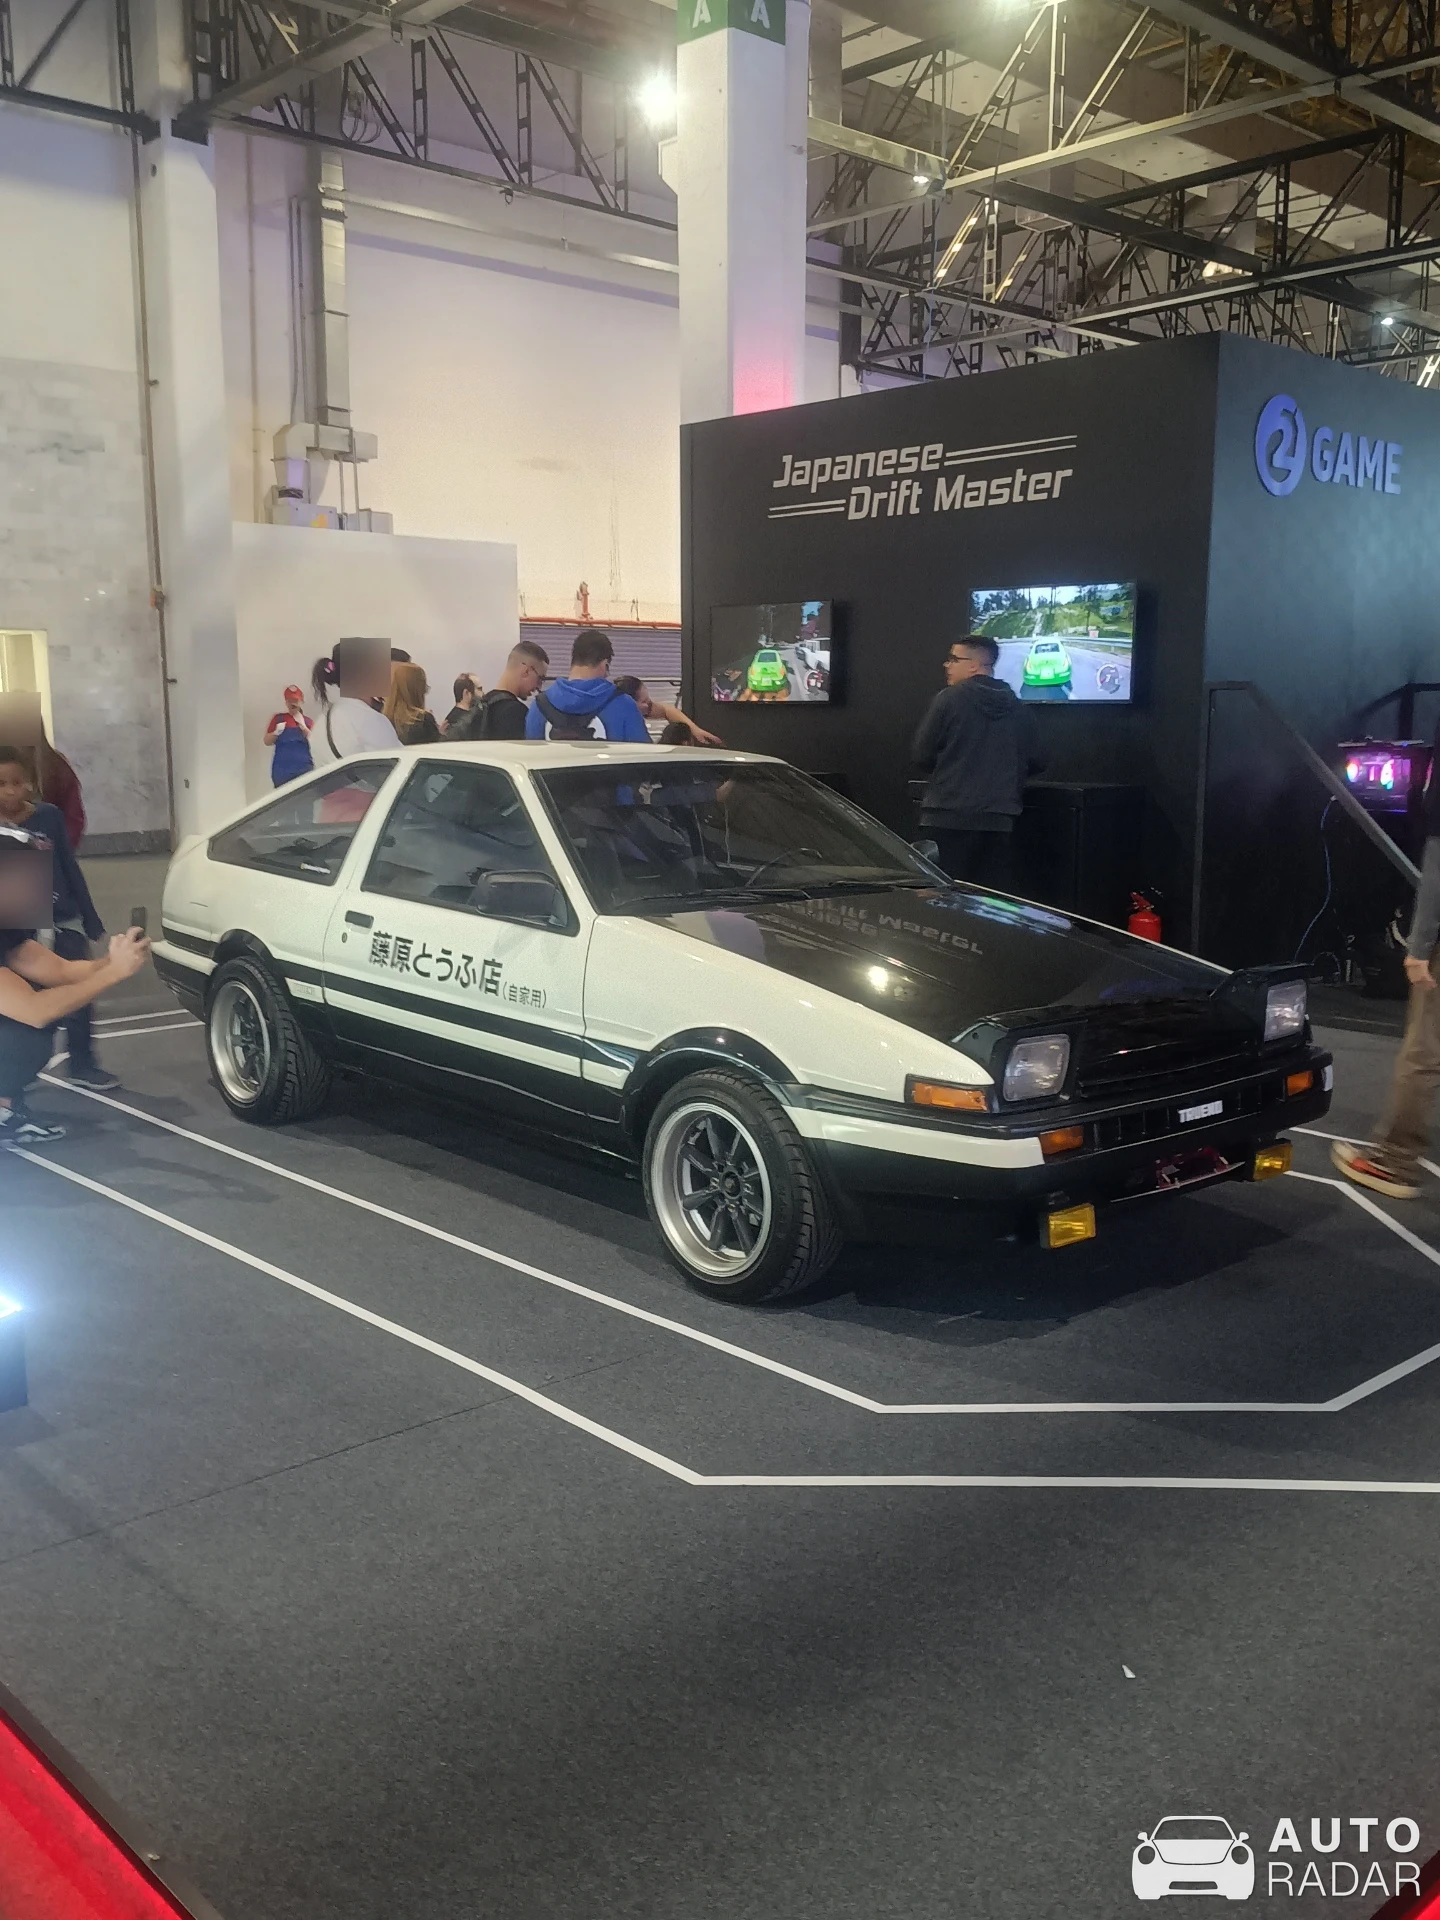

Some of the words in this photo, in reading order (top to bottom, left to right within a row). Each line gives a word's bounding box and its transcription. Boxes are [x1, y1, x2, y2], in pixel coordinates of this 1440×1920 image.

[692, 0, 711, 28] A
[750, 0, 770, 29] A
[772, 443, 944, 493] Japanese
[1311, 425, 1403, 495] GAME
[847, 478, 923, 520] Drift
[933, 468, 1073, 512] Master
